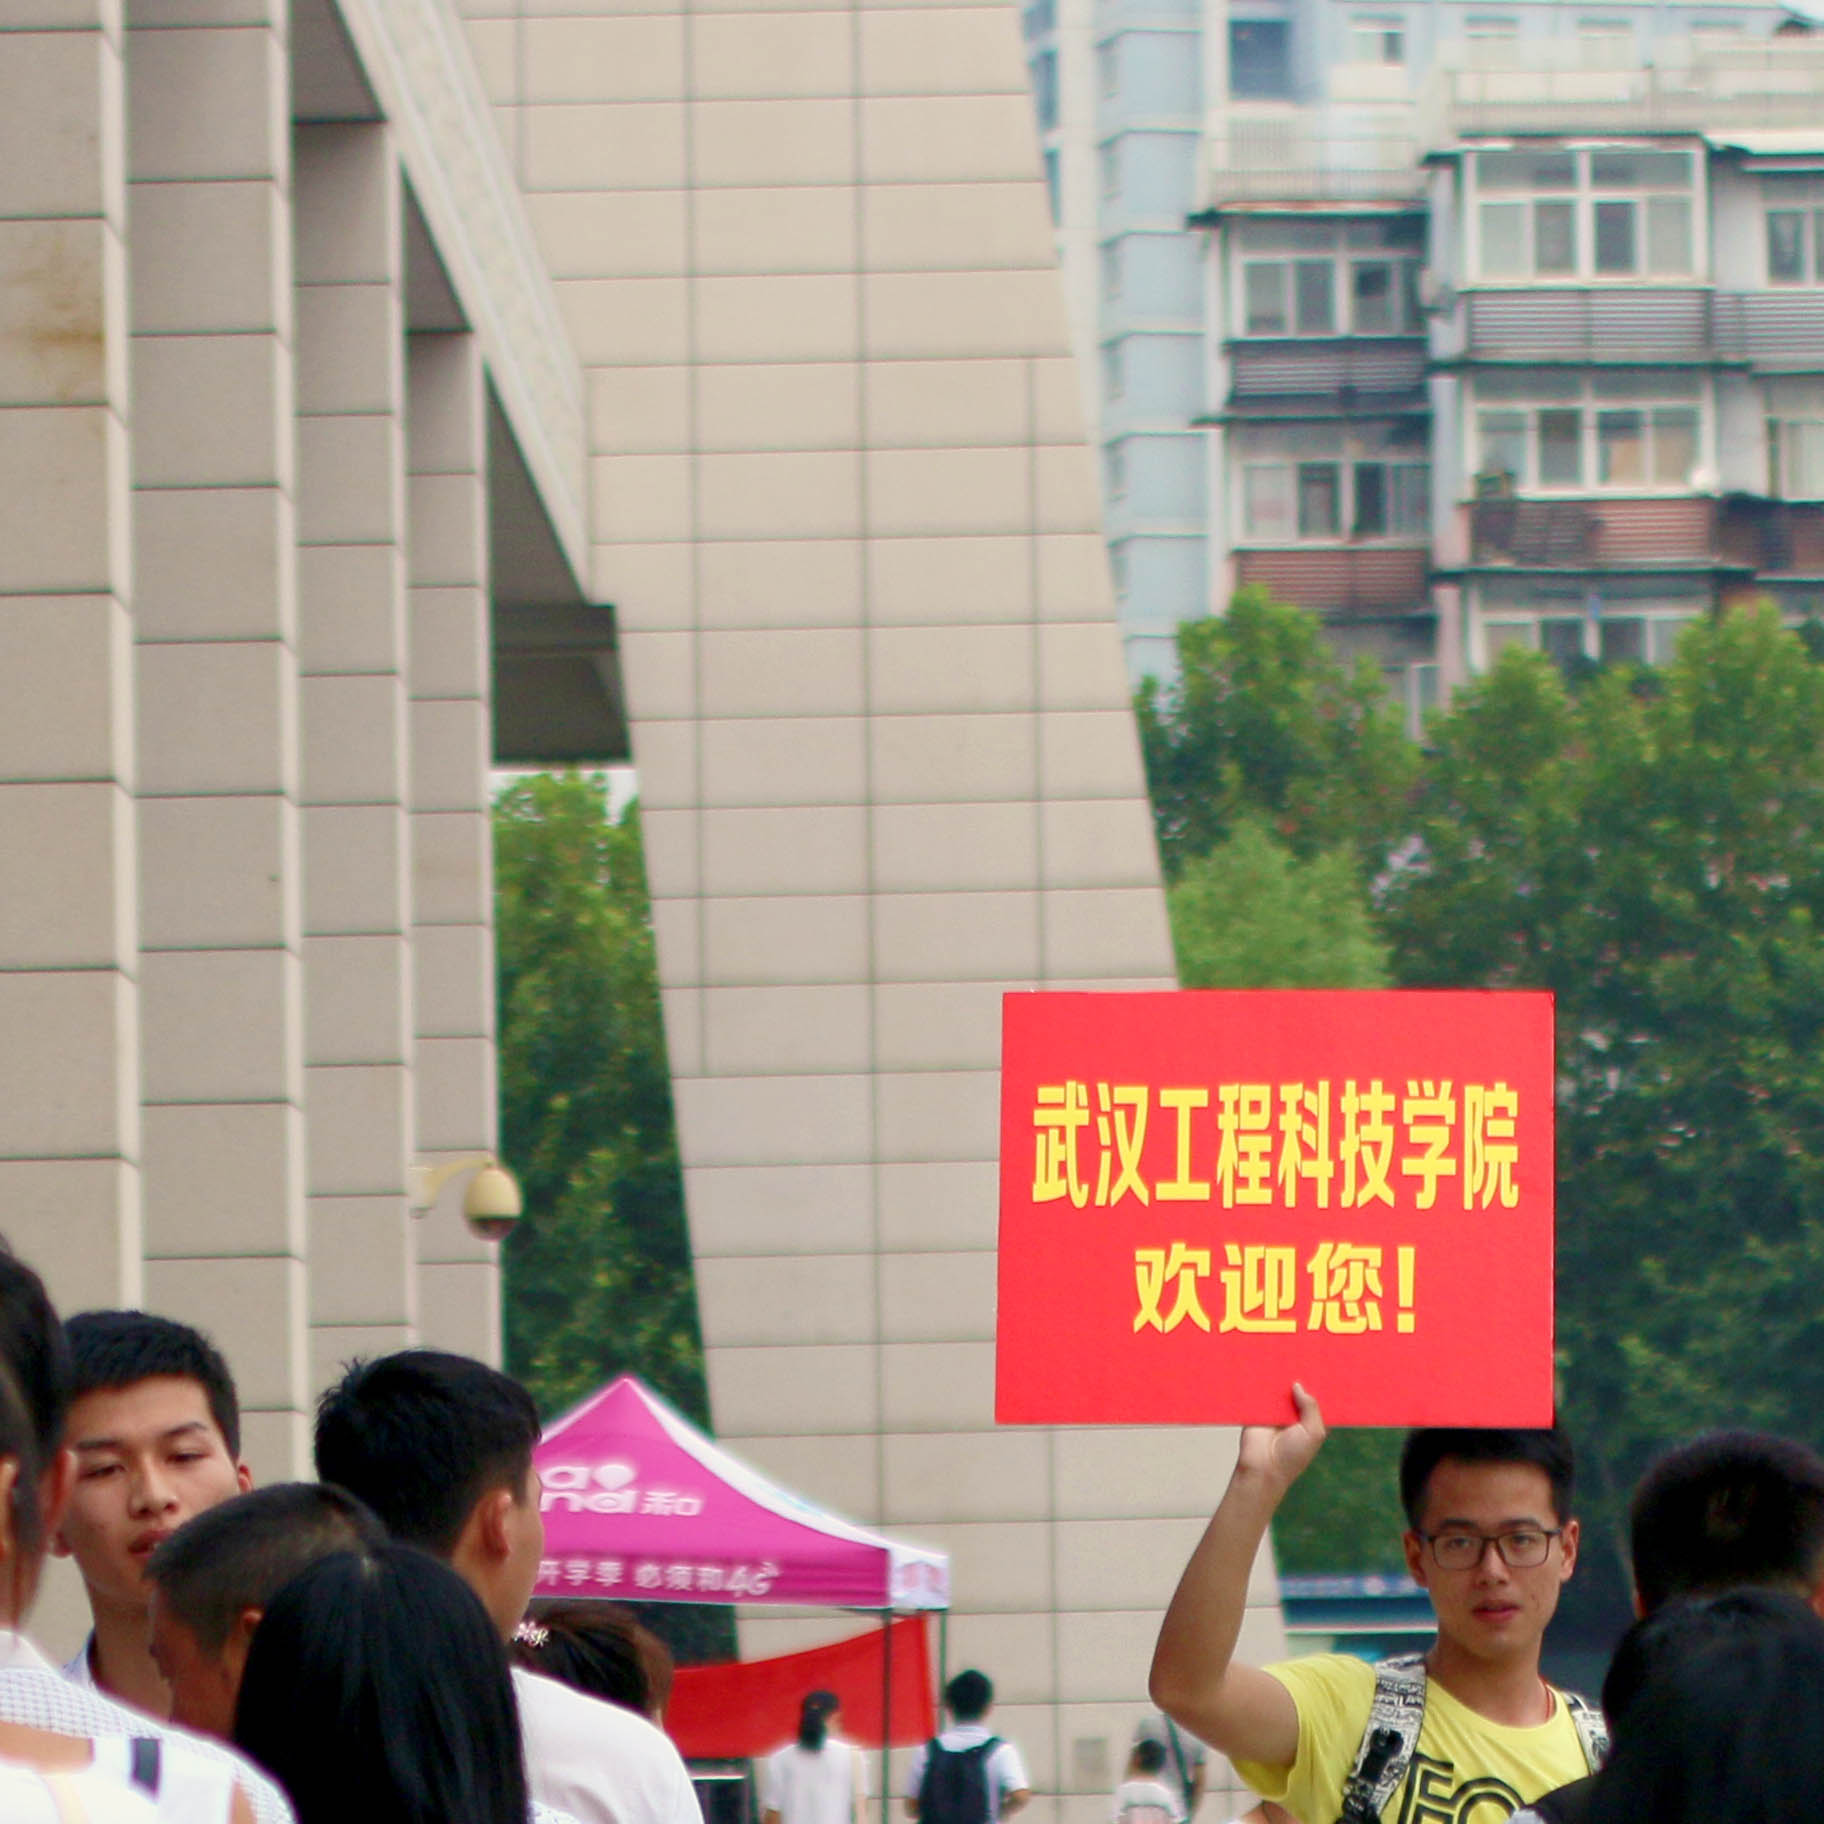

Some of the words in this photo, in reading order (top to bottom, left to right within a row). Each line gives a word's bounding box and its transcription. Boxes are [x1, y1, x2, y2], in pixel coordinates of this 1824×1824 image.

[1032, 1080, 1519, 1210] 武汉工程科技学院
[1132, 1240, 1416, 1334] 欢迎您!
